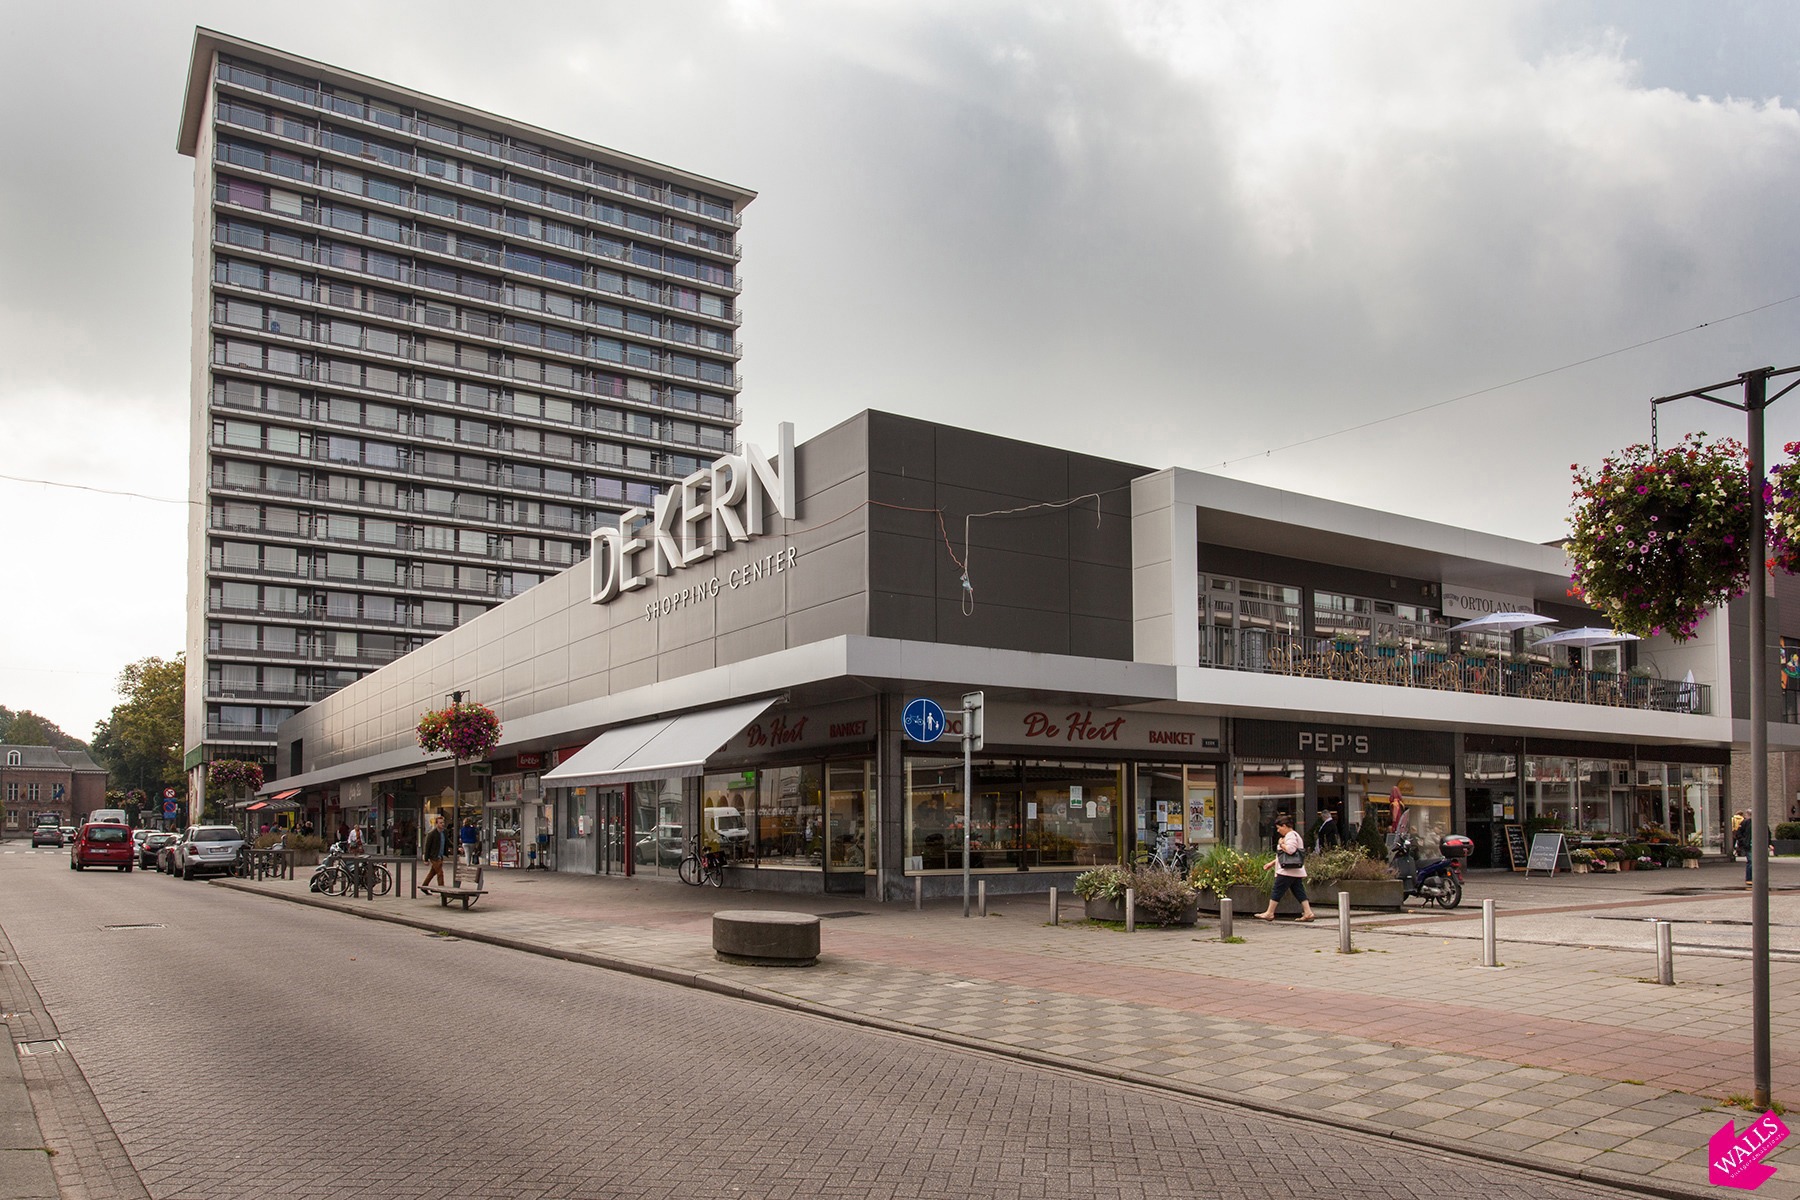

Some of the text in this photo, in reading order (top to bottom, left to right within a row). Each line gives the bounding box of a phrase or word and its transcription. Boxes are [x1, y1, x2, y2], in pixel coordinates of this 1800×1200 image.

[591, 421, 796, 604] DE KERN
[644, 546, 798, 622] SHOPPING CENTER
[1460, 595, 1517, 613] ORTOLANA
[747, 715, 809, 748] De Hert
[829, 720, 868, 739] BANKET
[1022, 711, 1126, 742] De Hert
[1148, 730, 1196, 746] BANKET
[1298, 731, 1369, 754] PEP'S
